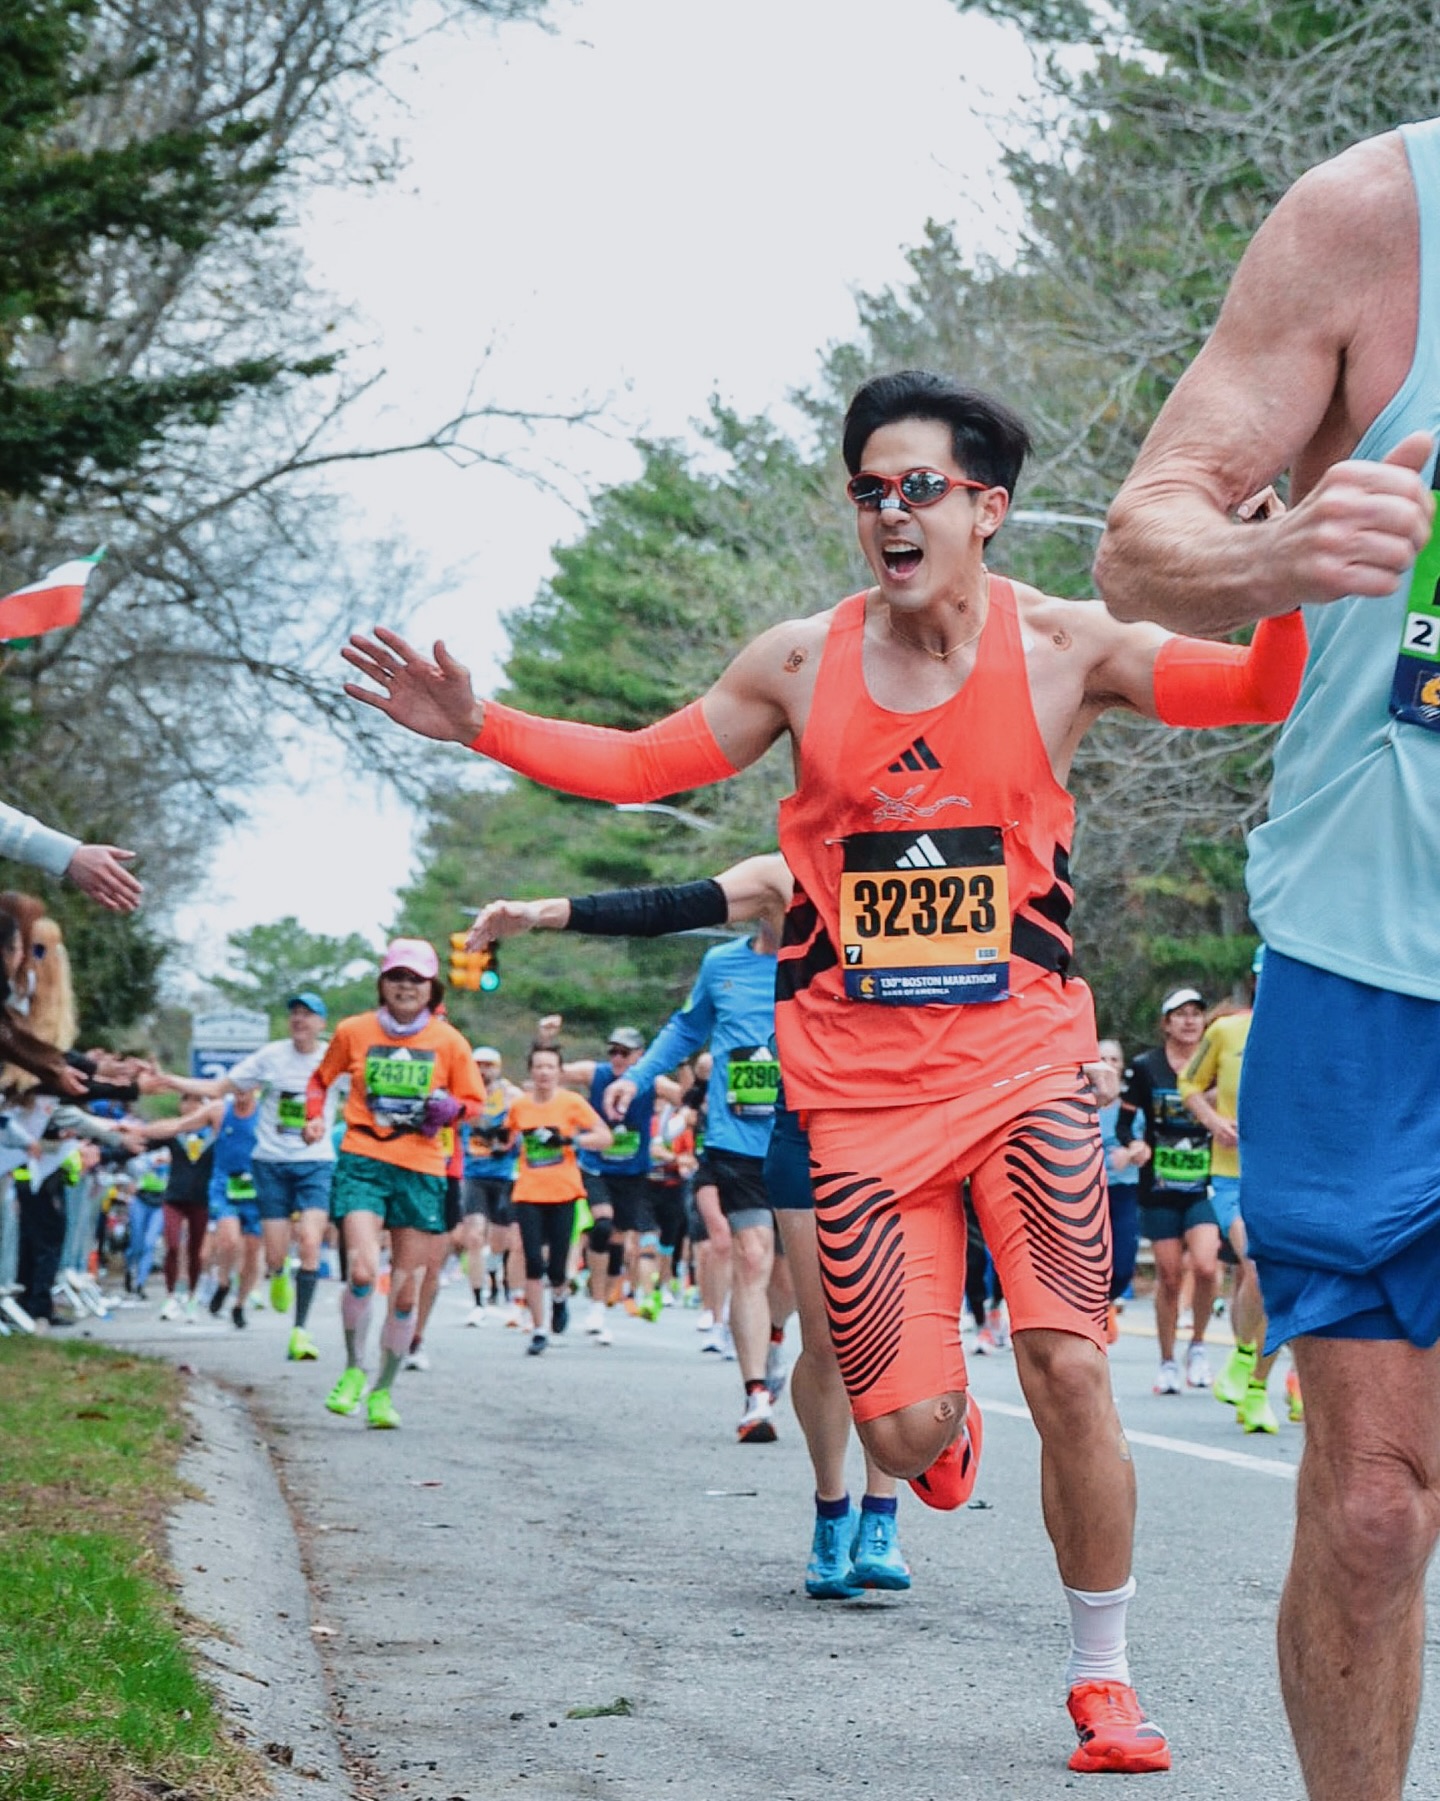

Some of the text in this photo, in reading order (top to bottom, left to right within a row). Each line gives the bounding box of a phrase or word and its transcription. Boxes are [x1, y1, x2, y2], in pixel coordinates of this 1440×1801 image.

[1411, 620, 1433, 647] 2
[854, 875, 996, 938] 32323
[846, 945, 861, 963] 7
[901, 976, 942, 988] BOSTON
[943, 973, 997, 986] MARATHON
[915, 988, 950, 996] AMERICA
[368, 1061, 428, 1086] 24313
